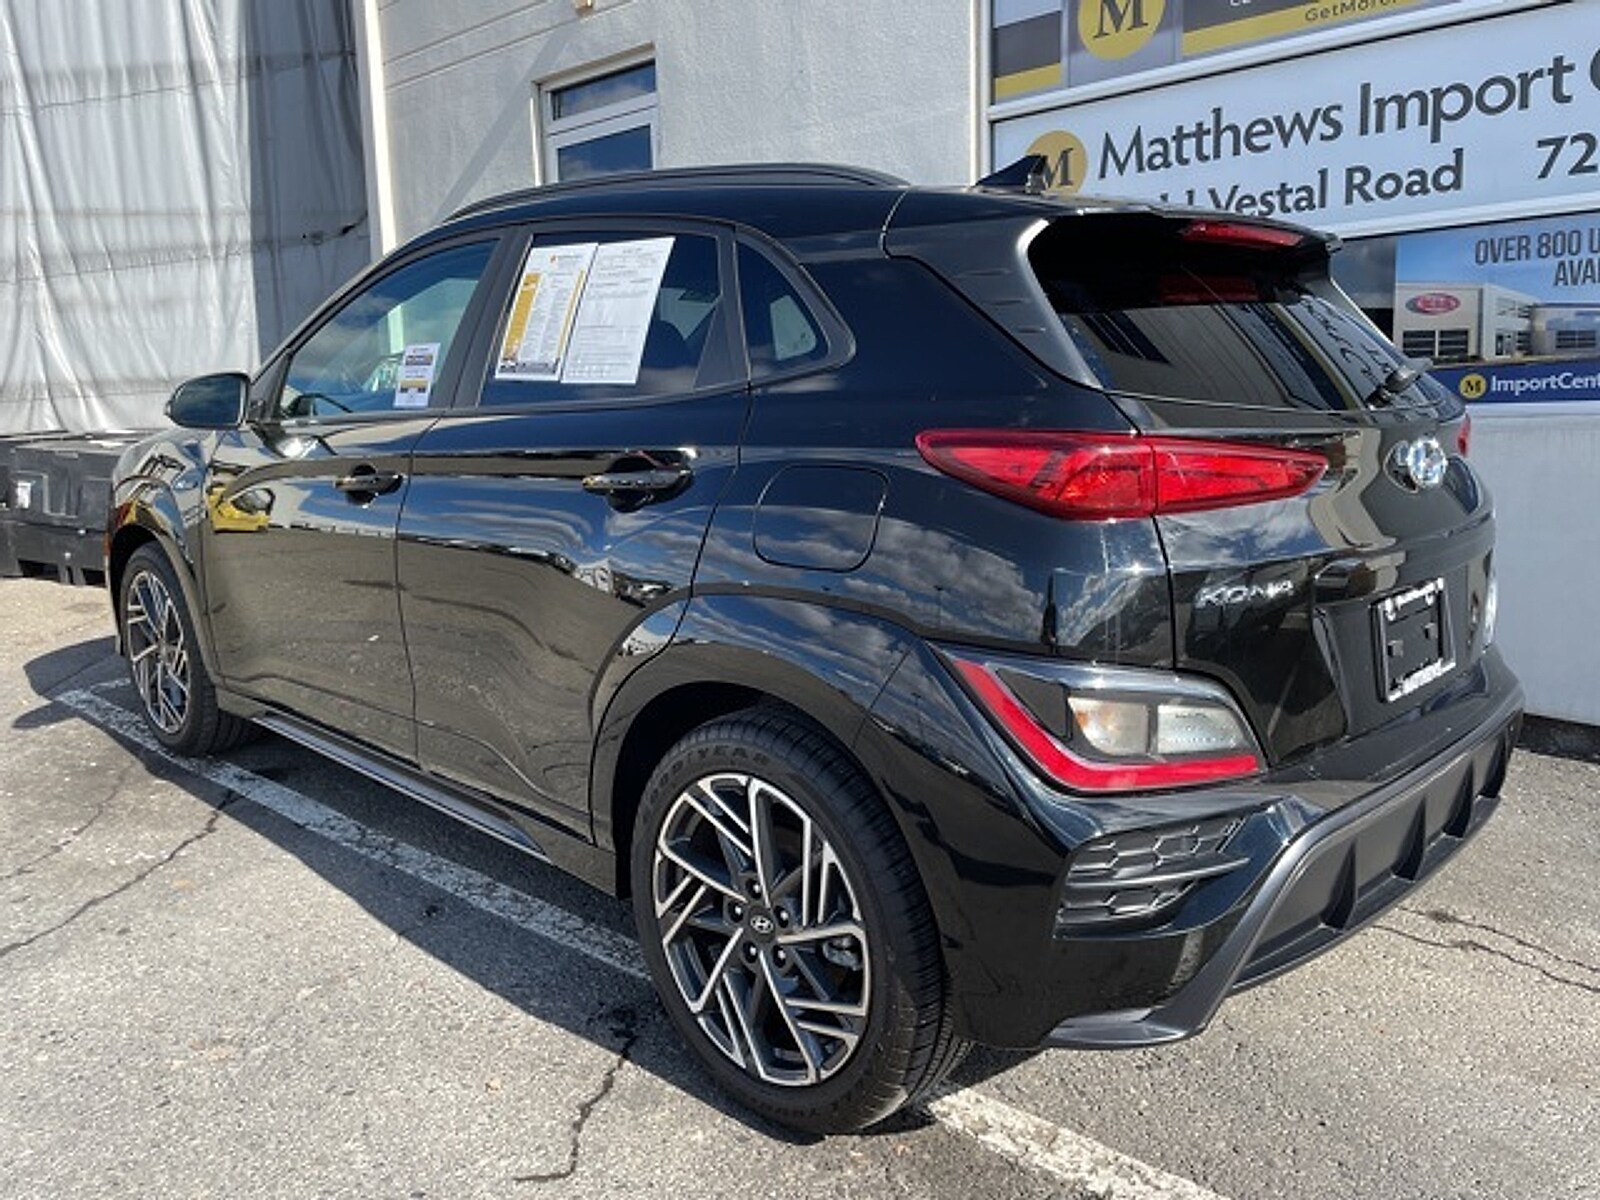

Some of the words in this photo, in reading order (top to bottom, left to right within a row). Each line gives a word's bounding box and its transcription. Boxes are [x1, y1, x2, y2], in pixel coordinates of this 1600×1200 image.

[1093, 0, 1149, 38] M
[1099, 103, 1343, 181] Matthews
[1360, 55, 1576, 144] Import
[1208, 168, 1329, 217] Vestal
[1345, 148, 1464, 206] Road
[1475, 235, 1531, 265] OVER
[1537, 230, 1582, 258] 800
